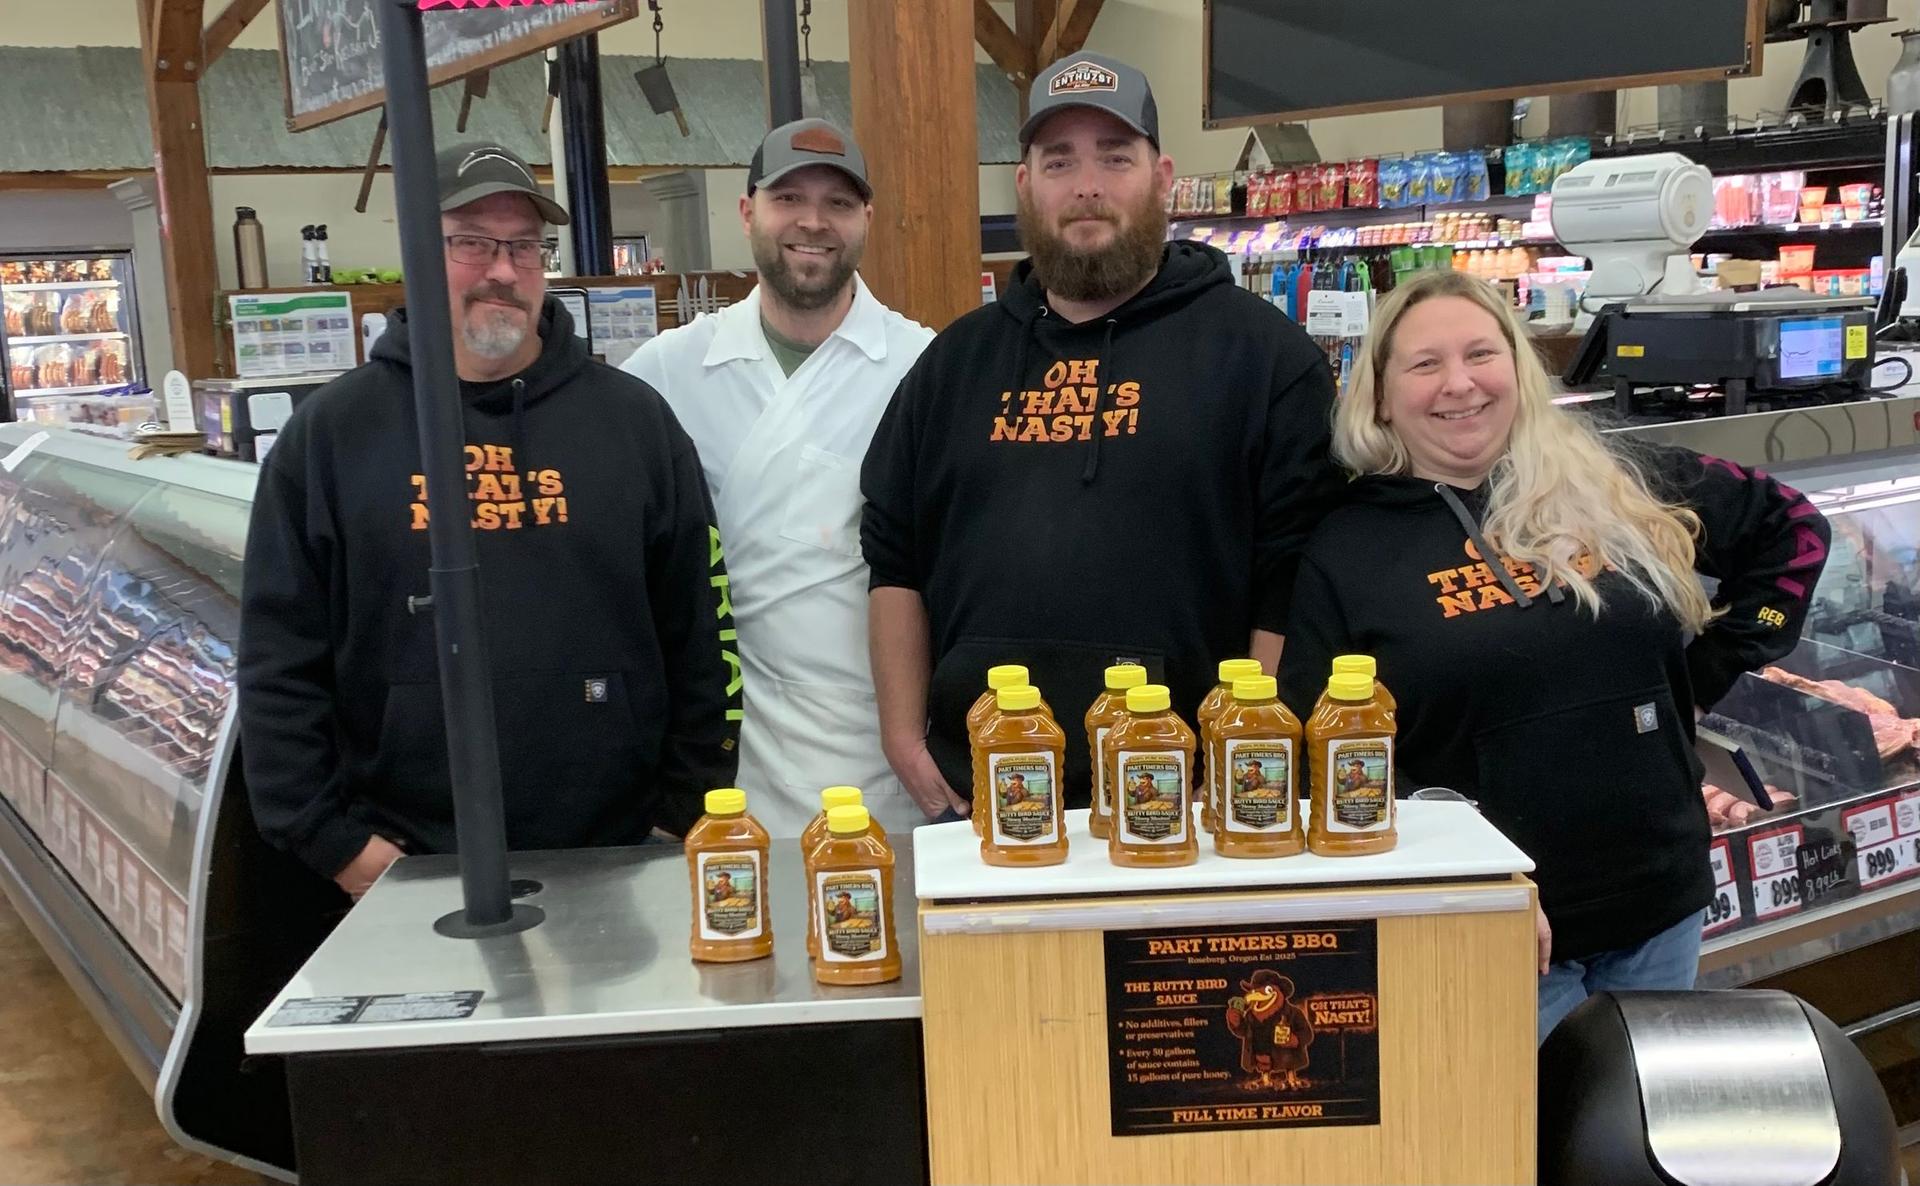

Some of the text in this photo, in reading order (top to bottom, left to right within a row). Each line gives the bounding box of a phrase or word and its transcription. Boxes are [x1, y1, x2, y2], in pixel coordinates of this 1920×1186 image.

[1044, 359, 1099, 389] OH
[990, 408, 1139, 442] NASTY!
[410, 468, 564, 501] TAT'S
[410, 497, 568, 530] NSTY!
[1337, 752, 1353, 760] PART
[1802, 849, 1819, 870] Hot
[1866, 847, 1894, 878] 899
[1771, 875, 1800, 907] 899
[1149, 933, 1338, 955] PART TIMERS BBQ
[1228, 954, 1258, 963] Oregon
[1259, 953, 1273, 961] Est
[1124, 979, 1228, 993] THE RUTTY BIRD
[1156, 994, 1198, 1006] SAUCE
[1310, 999, 1370, 1011] OH THAT'S
[1125, 1020, 1139, 1029] No
[1183, 1017, 1208, 1027] fillers
[1314, 1010, 1370, 1025] NASTY!
[1125, 1029, 1194, 1042] or preservatives
[1126, 1048, 1150, 1059] Every
[1164, 1047, 1196, 1057] gallons
[1126, 1059, 1200, 1069] of sauce contains
[1127, 1073, 1138, 1082] 15
[1139, 1072, 1170, 1083] gallons
[1171, 1071, 1181, 1080] of
[1181, 1072, 1202, 1082] pure
[1173, 1105, 1323, 1123] FULL TIME FLAVOR
